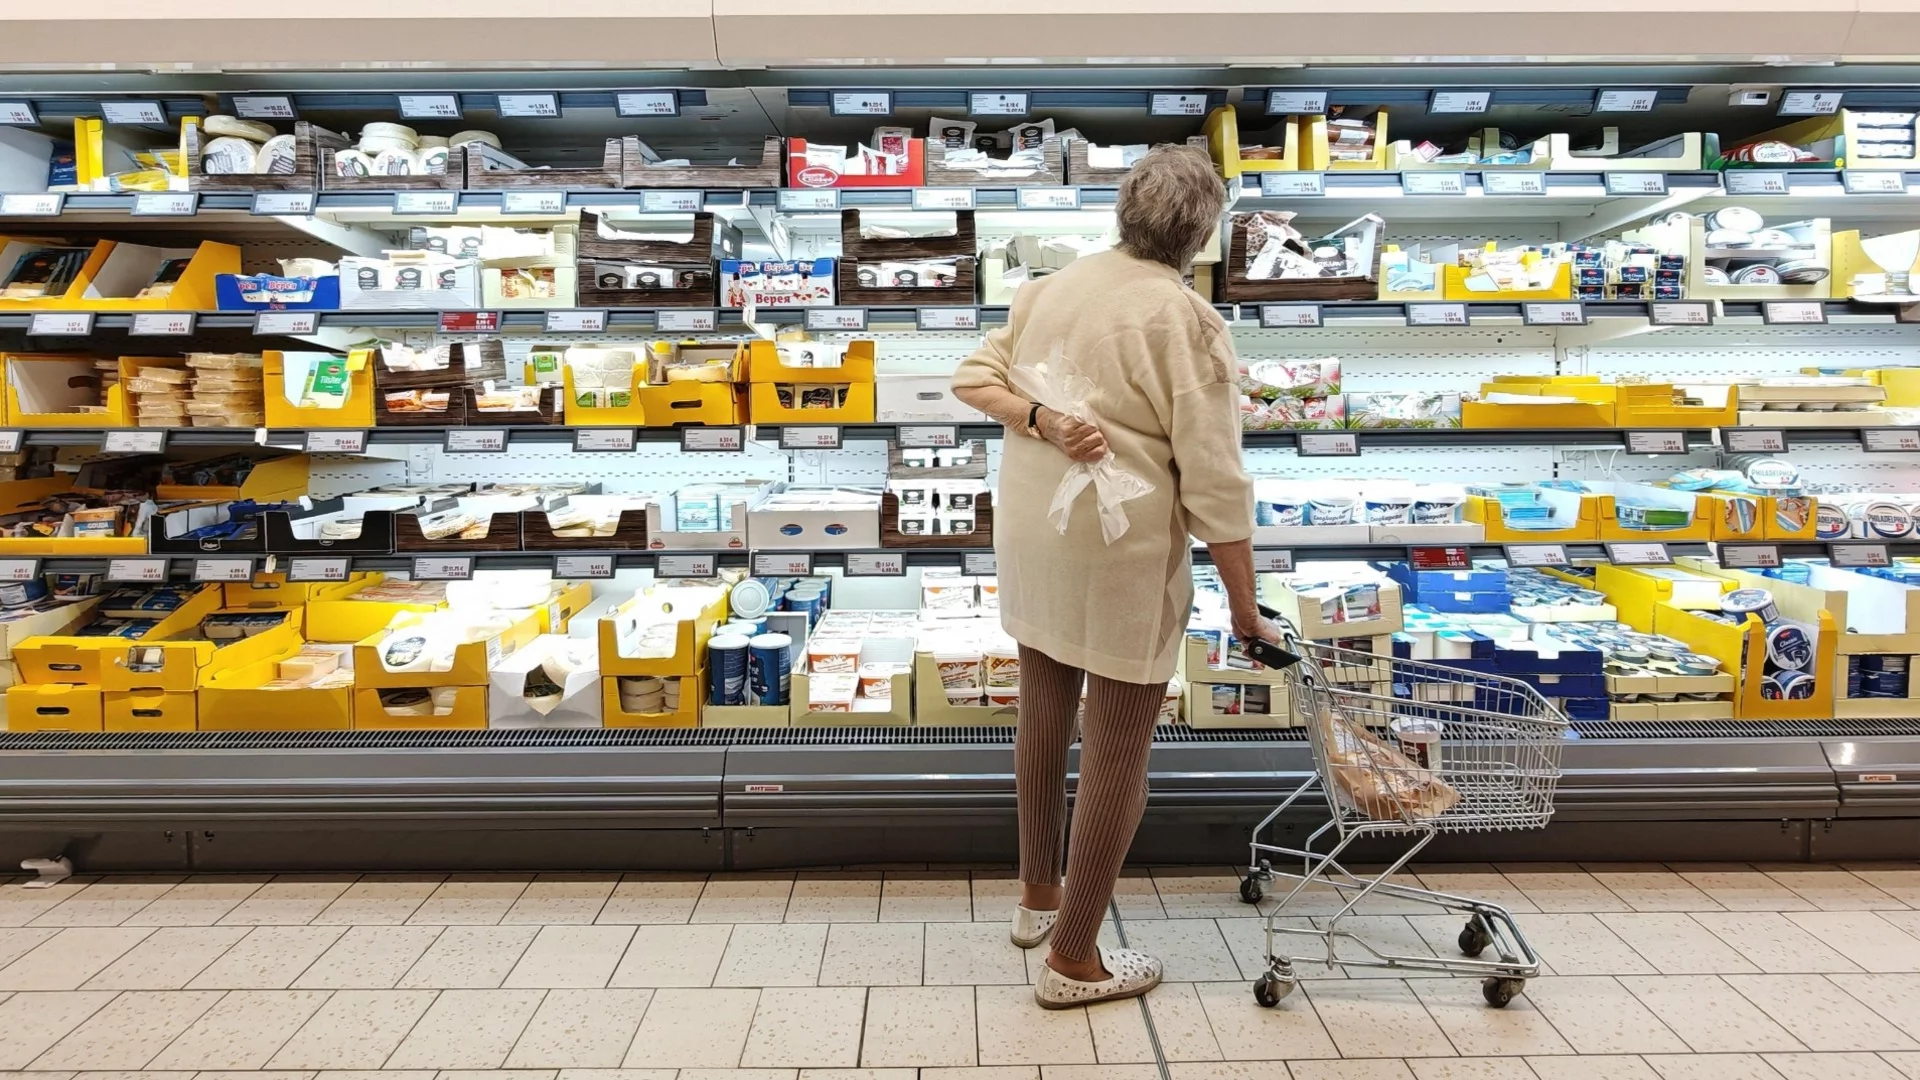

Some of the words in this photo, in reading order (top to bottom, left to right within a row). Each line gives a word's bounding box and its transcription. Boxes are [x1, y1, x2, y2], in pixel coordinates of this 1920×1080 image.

[268, 280, 296, 291] Верея
[755, 294, 791, 306] Верея
[1751, 469, 1793, 477] PHILADELPHIA
[1817, 516, 1844, 524] ADELPHIA
[1867, 514, 1908, 524] PHILADELPHIA
